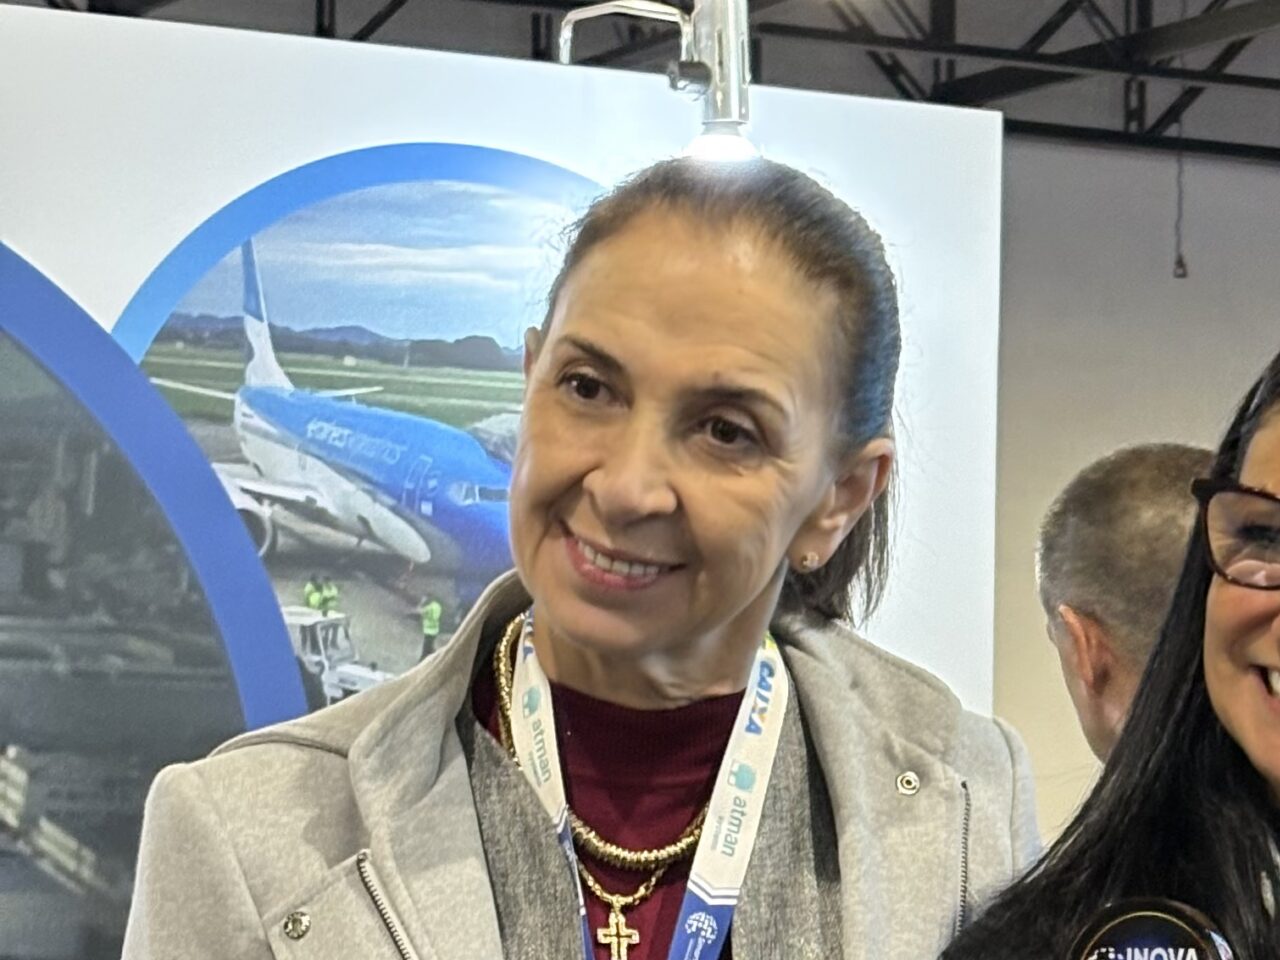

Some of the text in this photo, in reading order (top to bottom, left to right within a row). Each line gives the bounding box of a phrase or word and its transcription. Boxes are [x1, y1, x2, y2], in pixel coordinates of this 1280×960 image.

[744, 660, 775, 735] CAIXA
[531, 718, 551, 783] atman
[721, 796, 747, 857] atman
